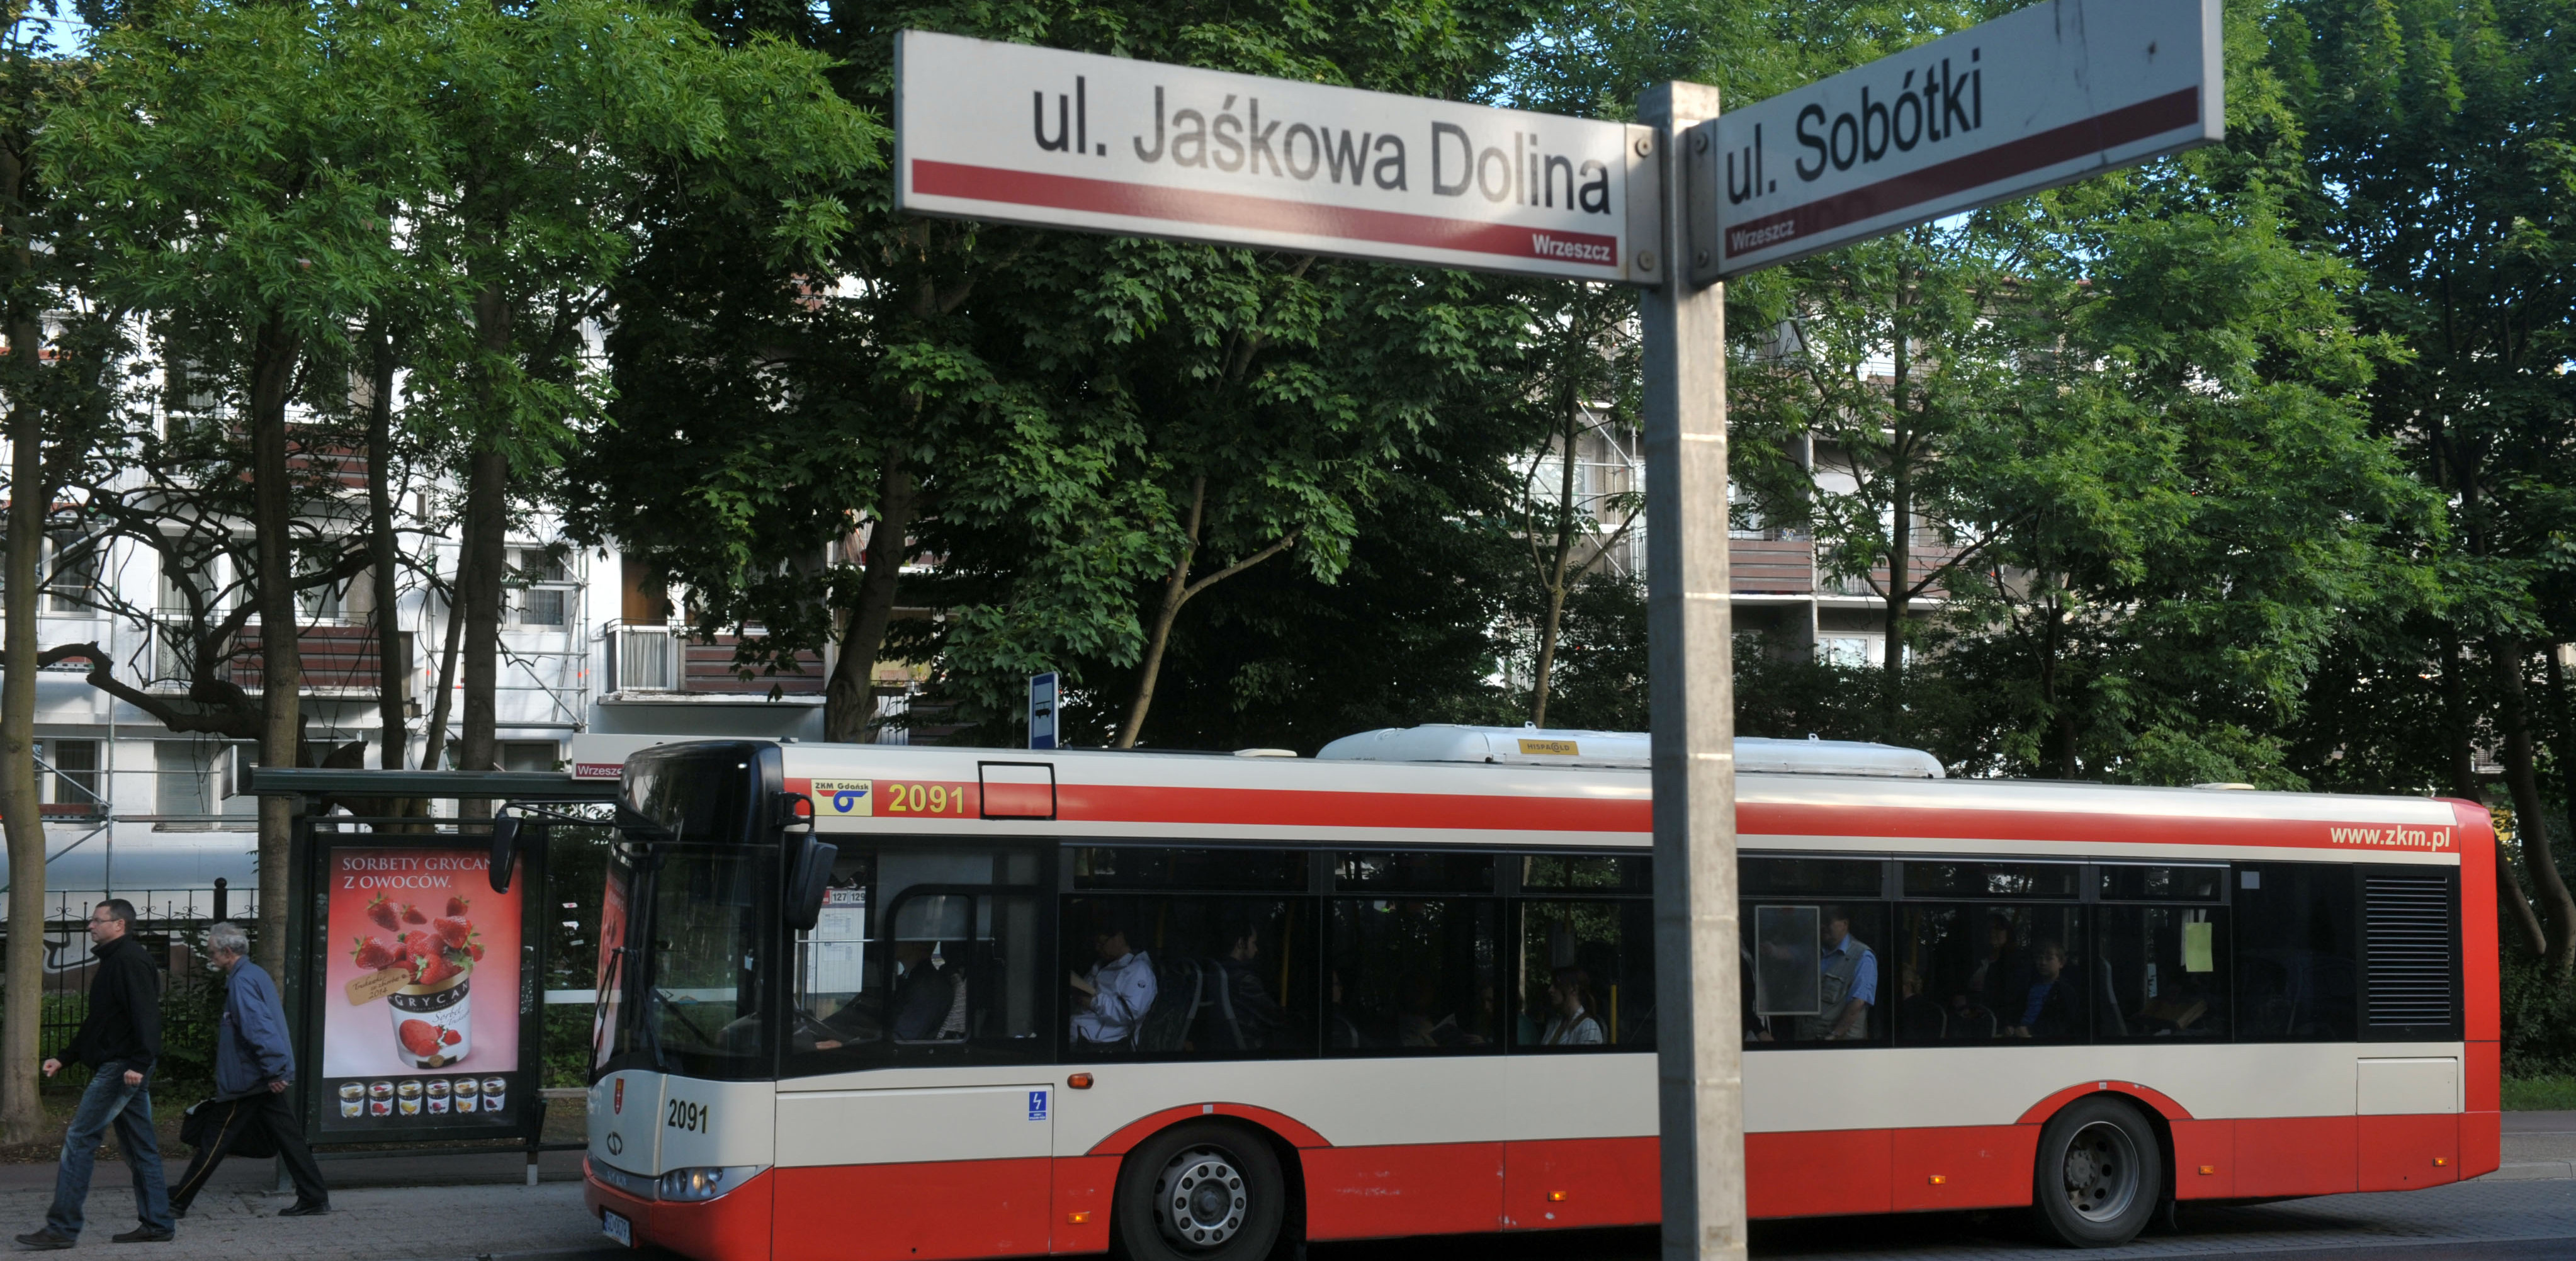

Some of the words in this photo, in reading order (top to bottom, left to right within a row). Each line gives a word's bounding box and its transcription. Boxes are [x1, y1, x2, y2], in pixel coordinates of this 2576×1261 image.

[1726, 123, 1778, 205] ul.
[1795, 47, 1982, 183] Sobótki
[1032, 76, 1107, 157] ul.
[1134, 85, 1408, 191] Jaśkowa
[1432, 121, 1611, 214] Dolina
[1532, 233, 1611, 261] Wrzeszcz
[1731, 220, 1795, 251] Wrzeszcz
[577, 765, 623, 776] Wrzeszc
[837, 781, 869, 791] Gdańsk
[888, 783, 964, 814] 2091
[2330, 825, 2451, 852] www.zkm.pl
[342, 857, 421, 871] SORBETY
[344, 876, 354, 888] Z
[359, 873, 452, 889] OWOCÓW.
[832, 893, 847, 902] 127
[851, 893, 866, 902] 129
[395, 982, 468, 1007] GRYCAN
[668, 1099, 709, 1134] 2091
